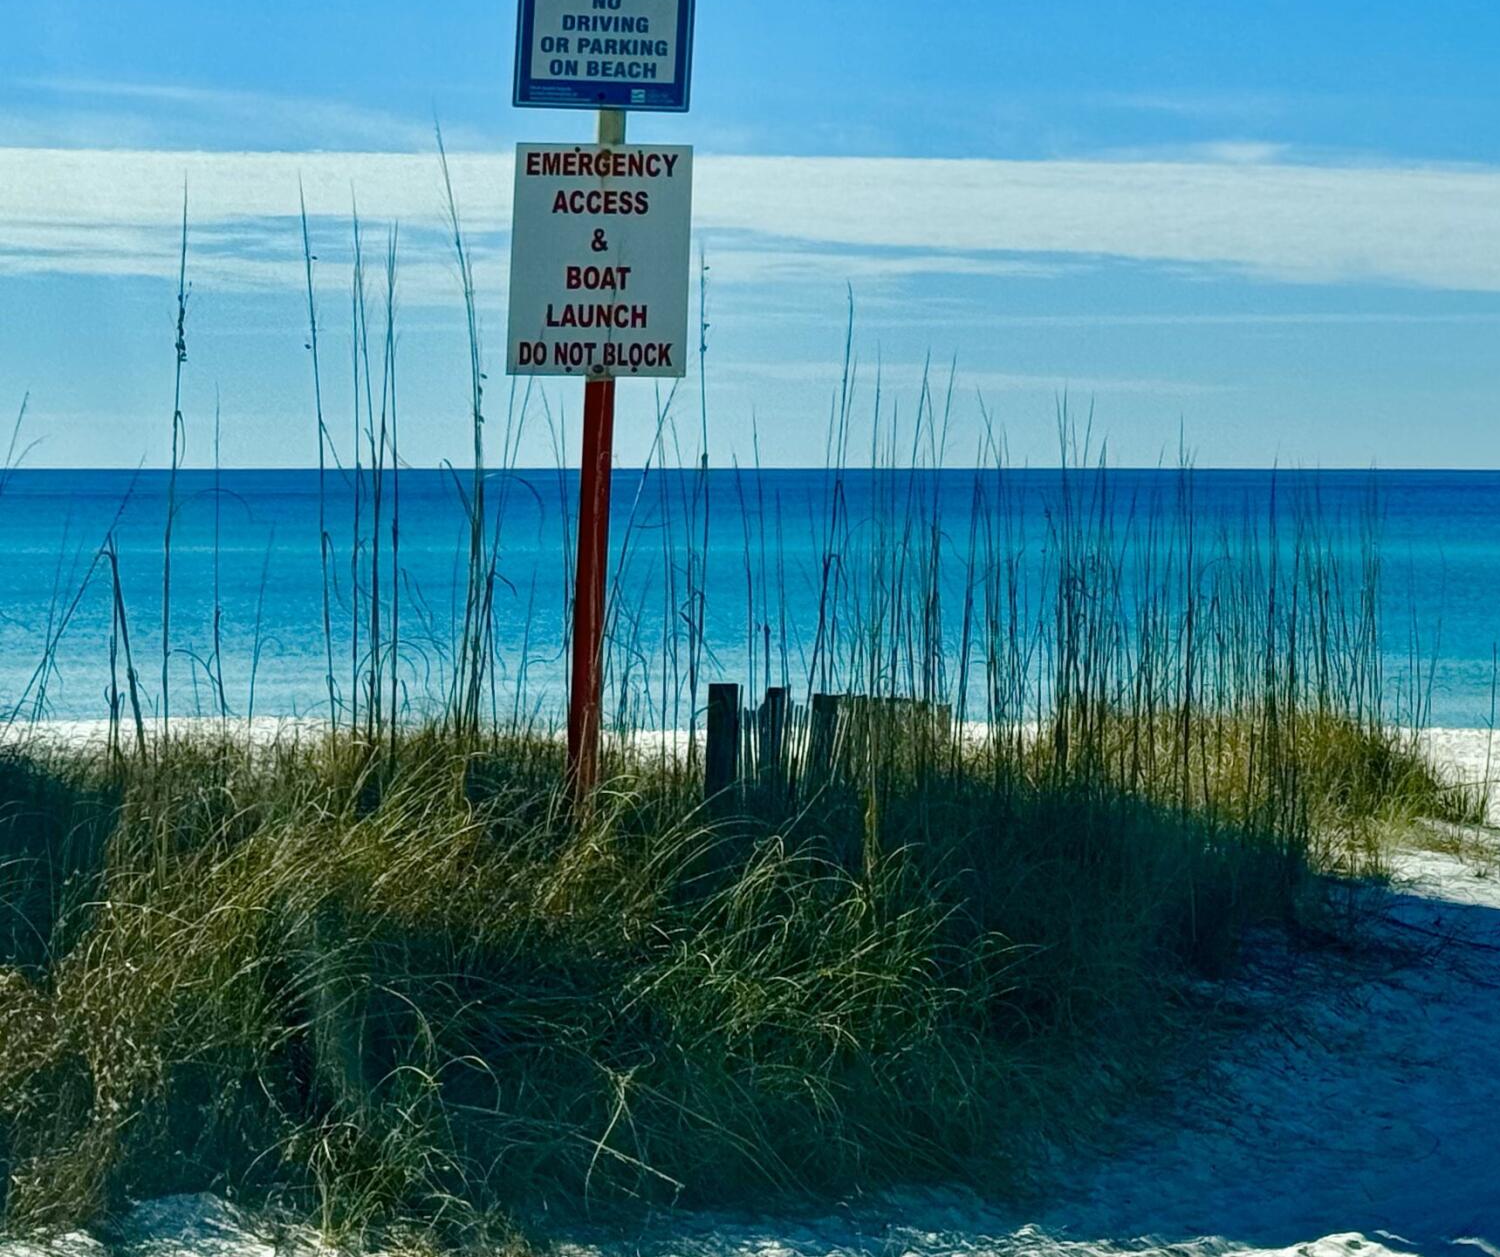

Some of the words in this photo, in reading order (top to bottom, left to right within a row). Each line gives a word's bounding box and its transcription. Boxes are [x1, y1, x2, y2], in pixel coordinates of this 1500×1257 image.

[562, 15, 649, 33] DRIVING
[540, 36, 569, 53] OR
[577, 38, 668, 56] PARKING
[550, 59, 578, 76] ON
[586, 60, 657, 79] BEACH
[526, 152, 679, 177] EMERGENCY
[552, 190, 649, 215] ACCESS
[591, 228, 608, 252] &
[566, 266, 631, 290] BOAT
[546, 304, 647, 328] LAUNCH
[519, 341, 547, 366] DO
[554, 342, 596, 366] NOT
[603, 342, 672, 367] BLOCK
